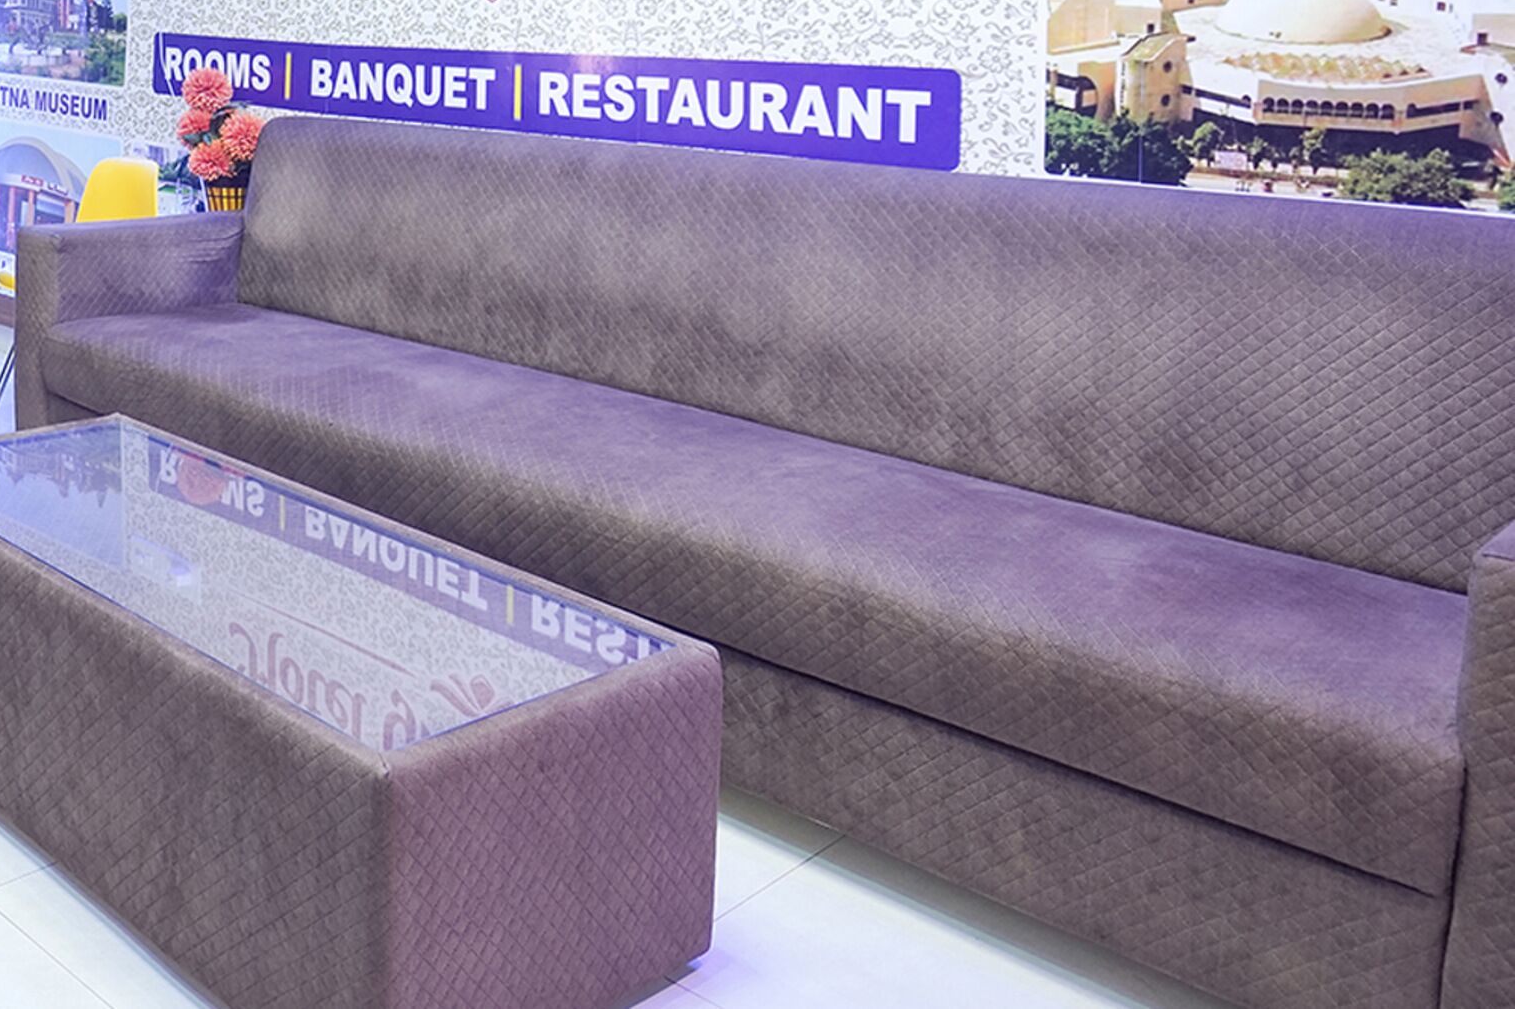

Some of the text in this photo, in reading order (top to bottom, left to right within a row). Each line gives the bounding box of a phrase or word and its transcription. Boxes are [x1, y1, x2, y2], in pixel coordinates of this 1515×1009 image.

[35, 89, 108, 122] MUSEUM
[165, 46, 932, 144] ROOMS BANQUET RESTAURANT
